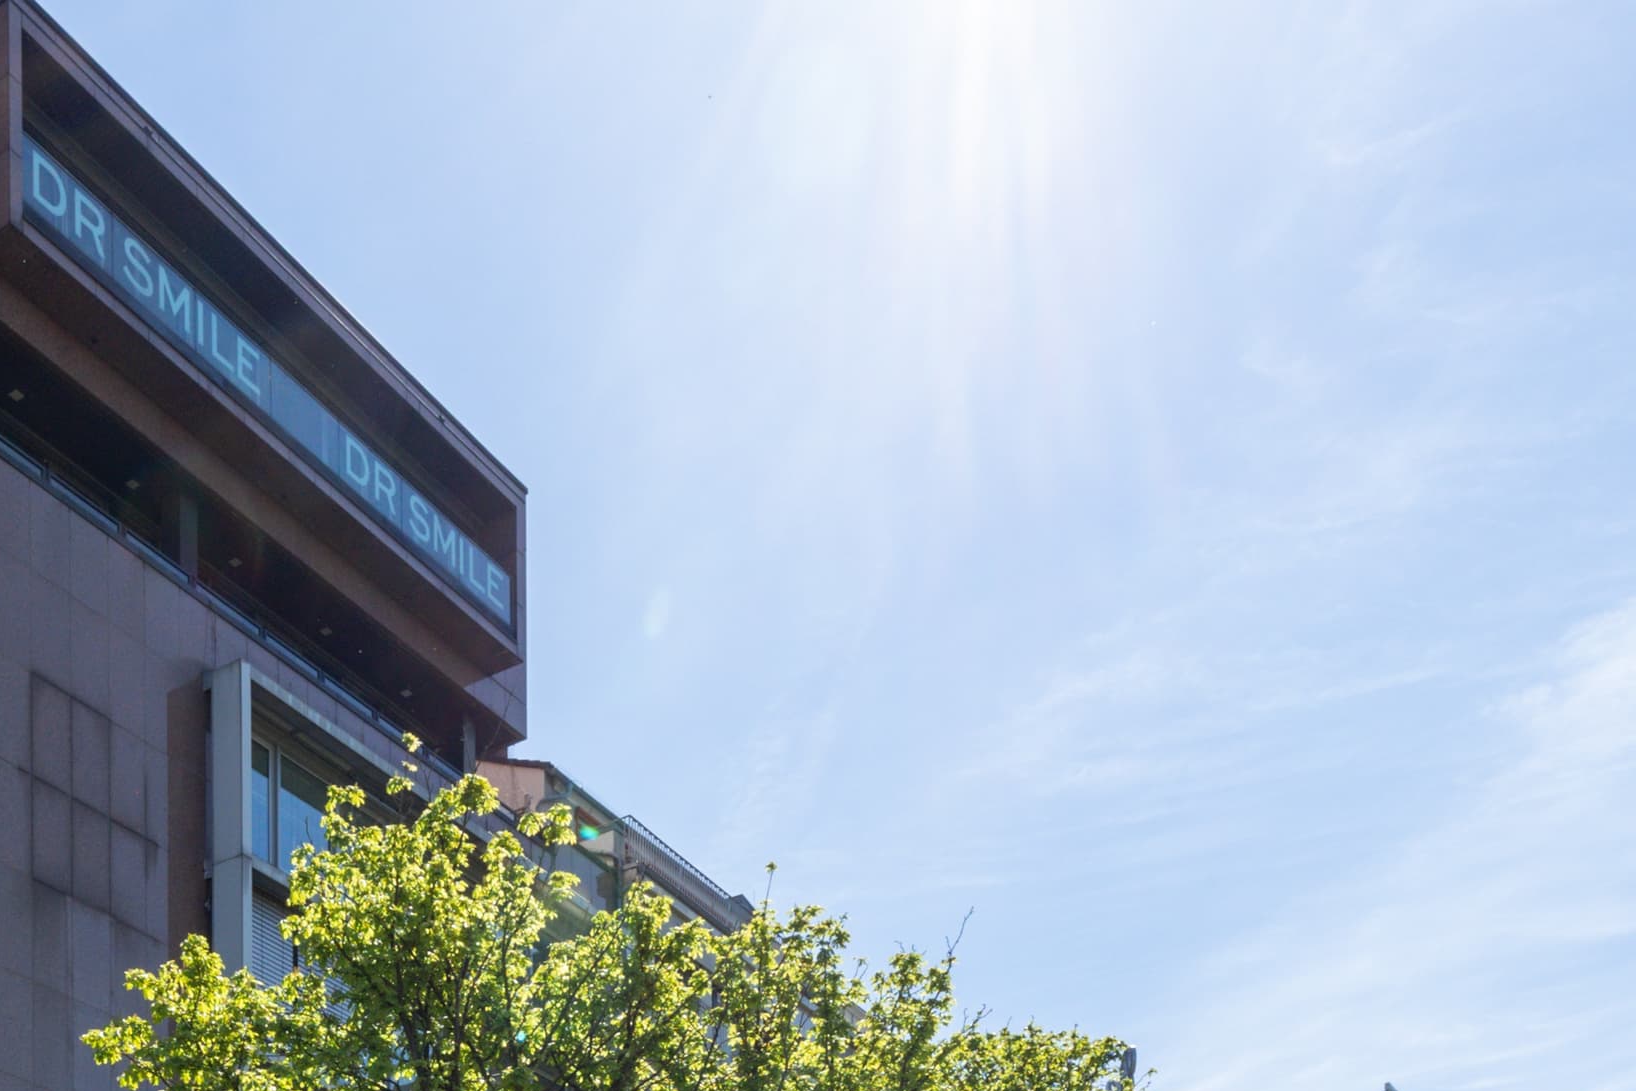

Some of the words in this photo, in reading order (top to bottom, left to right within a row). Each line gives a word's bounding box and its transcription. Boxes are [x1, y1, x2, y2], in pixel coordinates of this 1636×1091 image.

[33, 151, 105, 266] DR
[123, 237, 261, 399] SMILE
[346, 435, 396, 518] DR
[408, 494, 507, 610] SMILE
